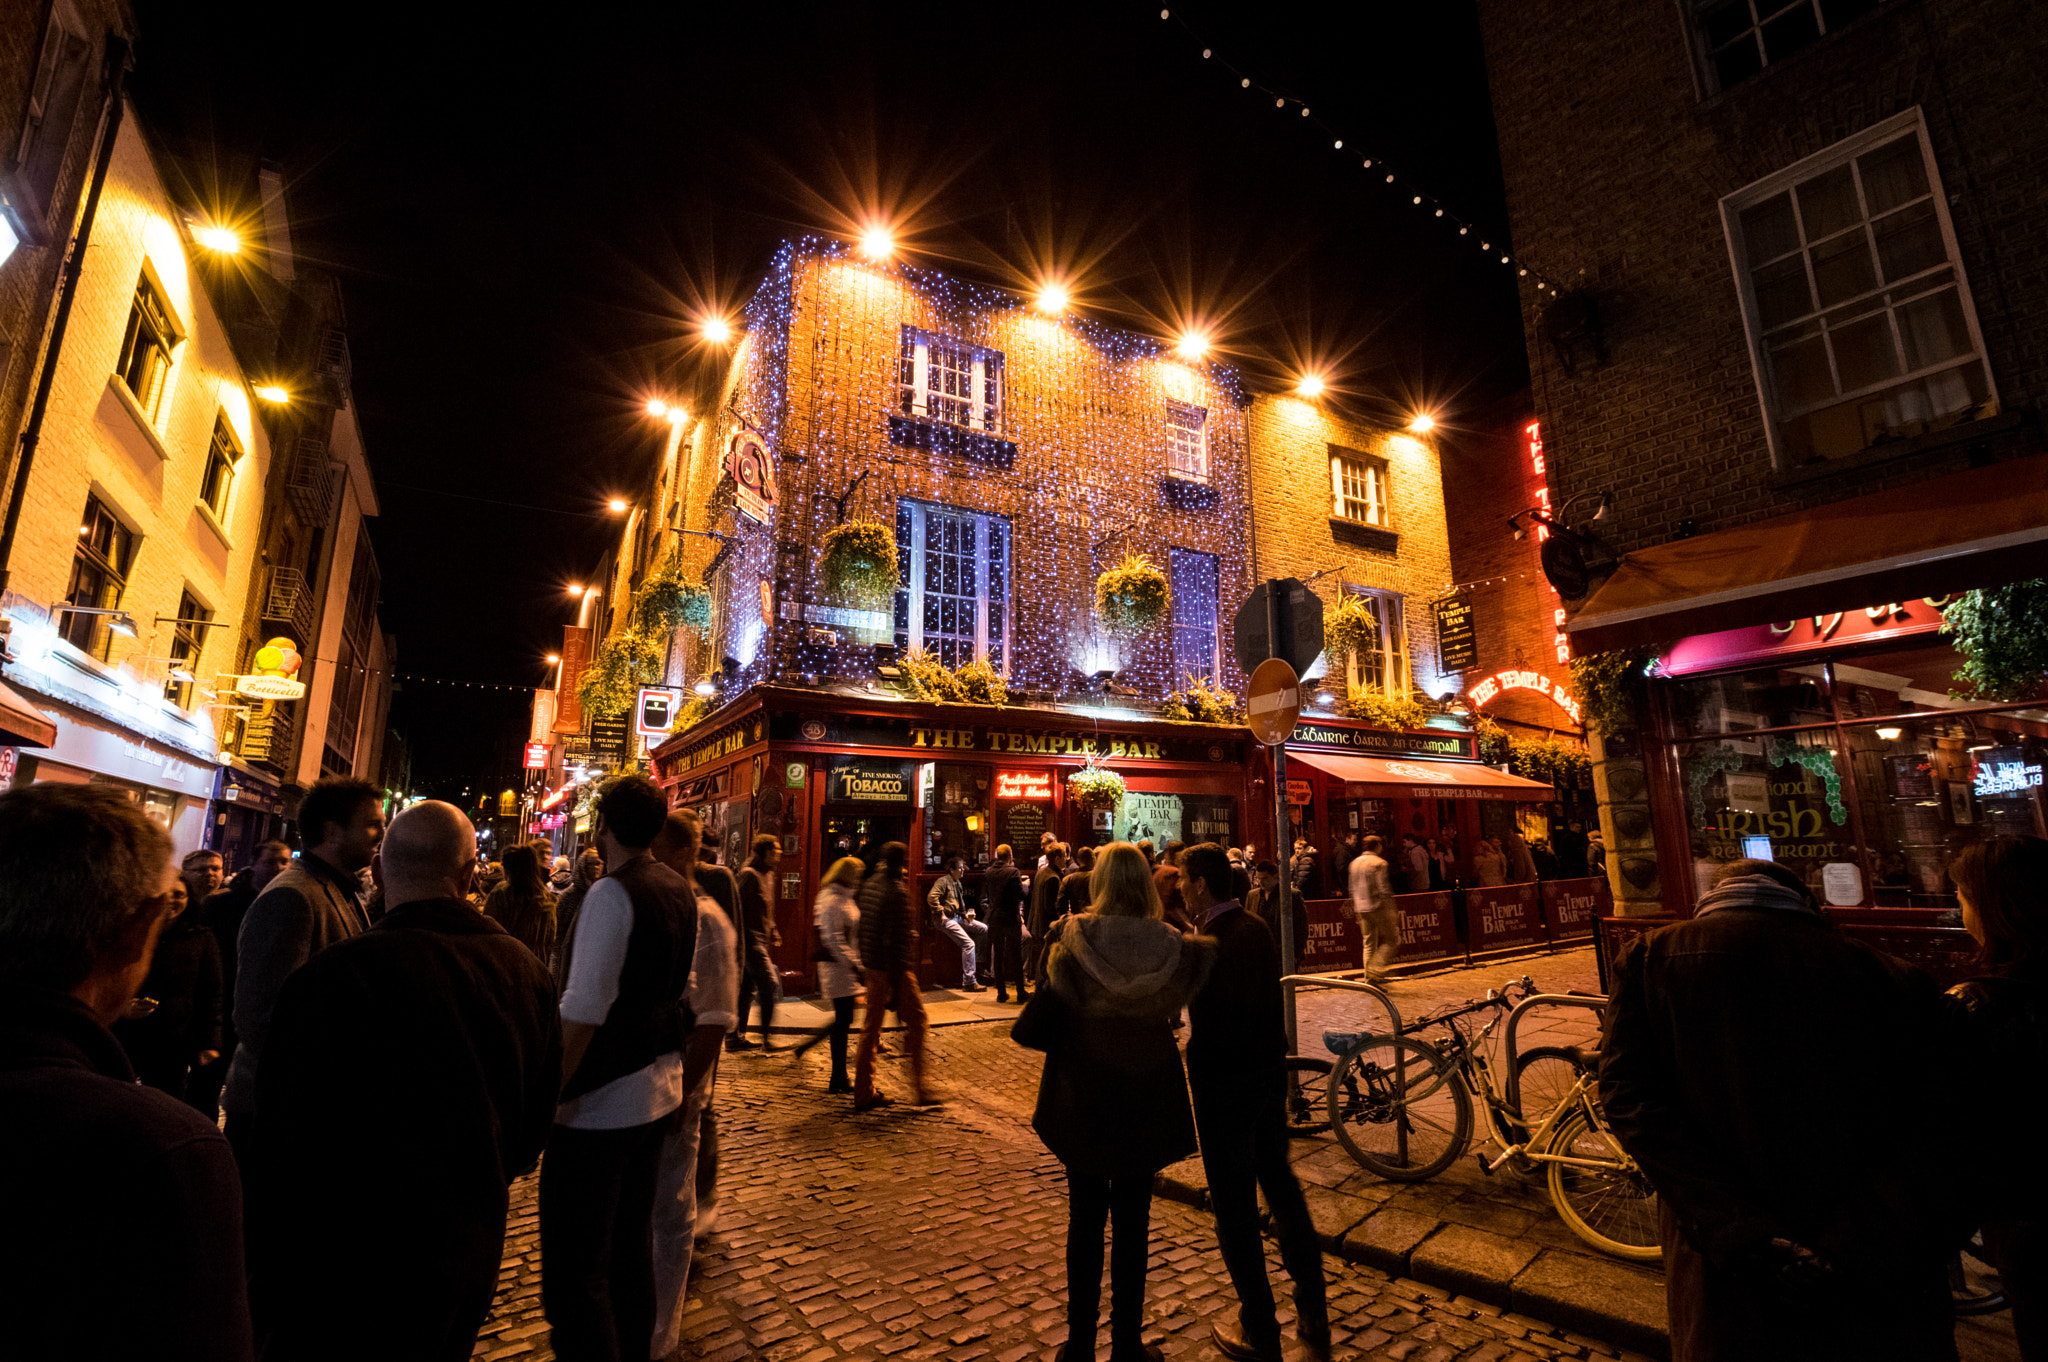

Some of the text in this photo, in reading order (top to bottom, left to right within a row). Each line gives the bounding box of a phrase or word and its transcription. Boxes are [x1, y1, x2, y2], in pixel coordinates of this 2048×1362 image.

[1527, 422, 1546, 475] THE
[1438, 605, 1471, 619] TEMPLE
[1448, 602, 1460, 610] THE
[1446, 616, 1465, 627] BAR
[568, 645, 577, 663] BAR
[564, 664, 575, 697] TEMPLE
[244, 683, 300, 697] Botticelli
[1468, 677, 1499, 707] THE
[1496, 670, 1551, 694] TEMPLE
[909, 727, 1161, 759] THE TEMPLE BAR
[677, 756, 691, 774] THE
[693, 740, 722, 767] TEMPLE
[725, 730, 744, 754] BAR
[997, 773, 1049, 785] Traditional
[997, 785, 1052, 798] Irish Music
[1412, 788, 1431, 798] THE
[1433, 788, 1465, 798] TEMPLE
[1466, 789, 1483, 799] BAR
[1008, 803, 1031, 815] TEMPLE
[1137, 798, 1181, 809] TEMPLE
[1150, 809, 1171, 821] BAR
[1213, 808, 1229, 820] THE
[1191, 822, 1230, 835] EMPEROR
[1490, 901, 1524, 920] TEMPLE
[1558, 906, 1580, 924] BAR
[1399, 910, 1440, 931] TEMPLE
[1482, 915, 1506, 934] BAR
[1307, 922, 1345, 938] EMPLE
